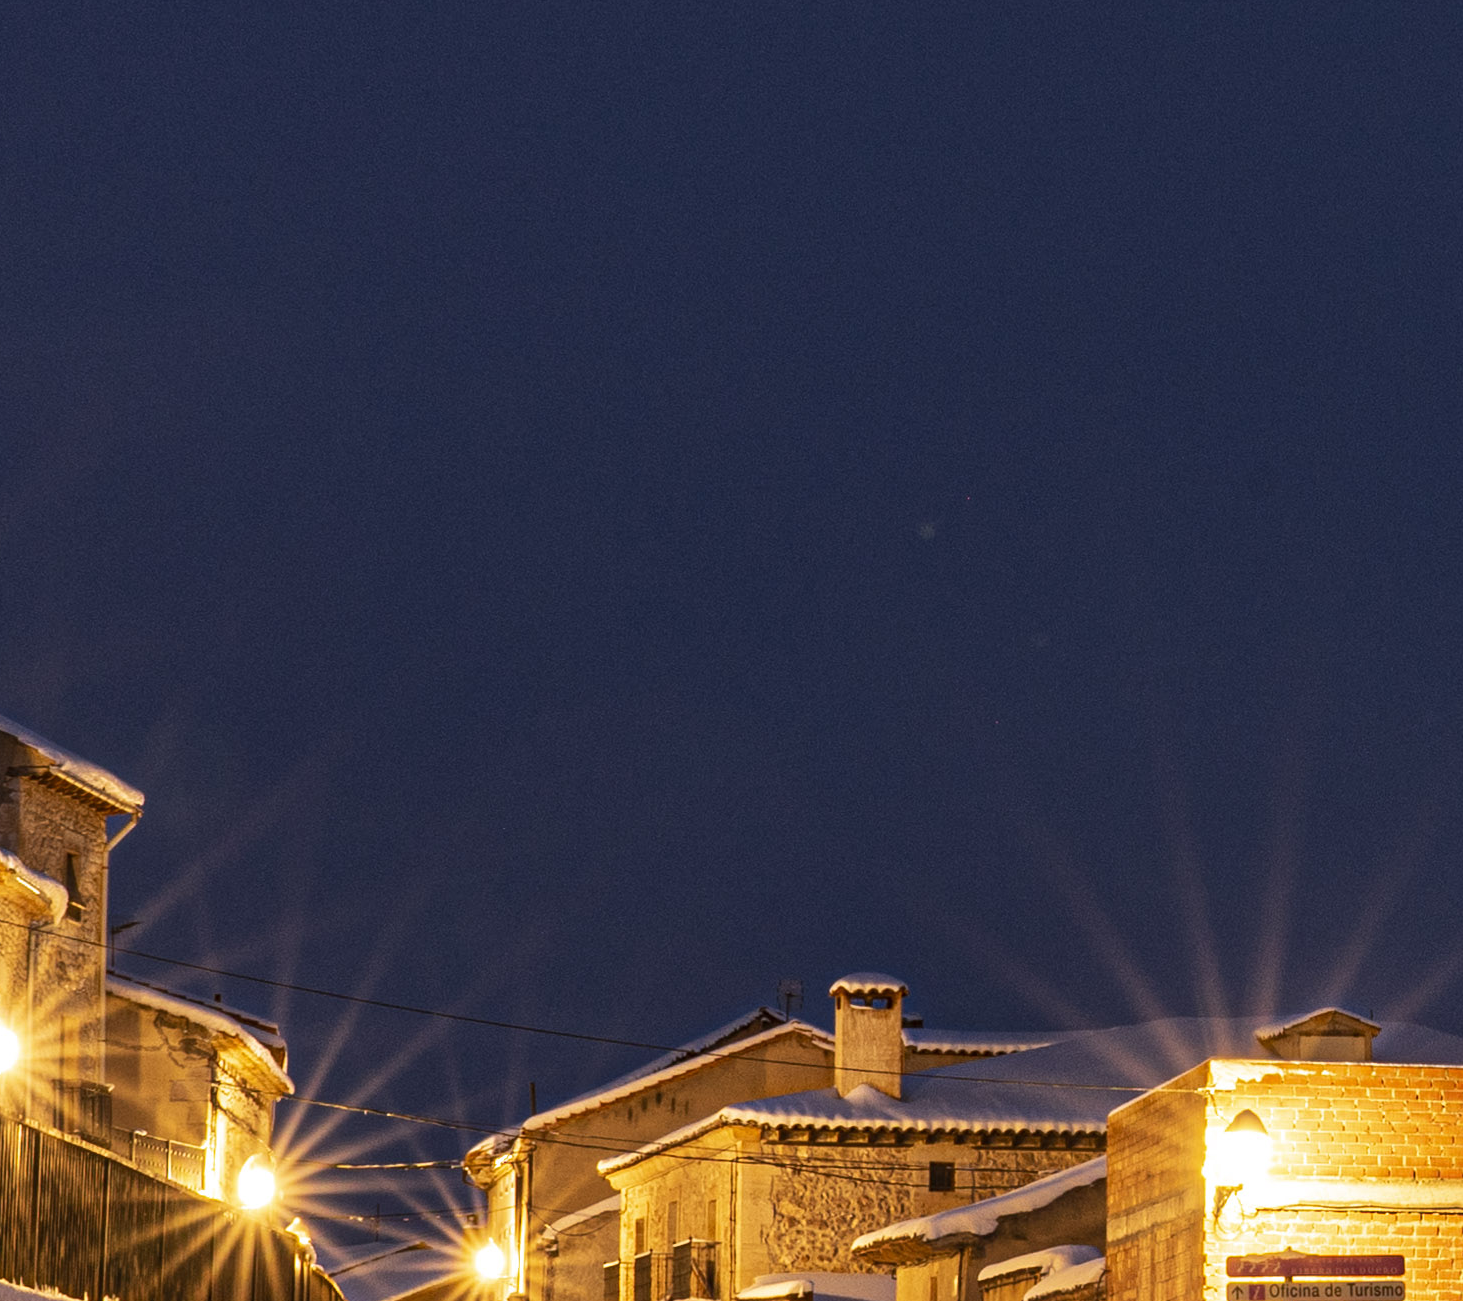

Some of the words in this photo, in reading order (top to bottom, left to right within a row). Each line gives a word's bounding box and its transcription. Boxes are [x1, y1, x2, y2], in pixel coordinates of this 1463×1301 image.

[1269, 1283, 1320, 1298] Oficina
[1325, 1283, 1342, 1297] de
[1347, 1282, 1403, 1297] Turismo
